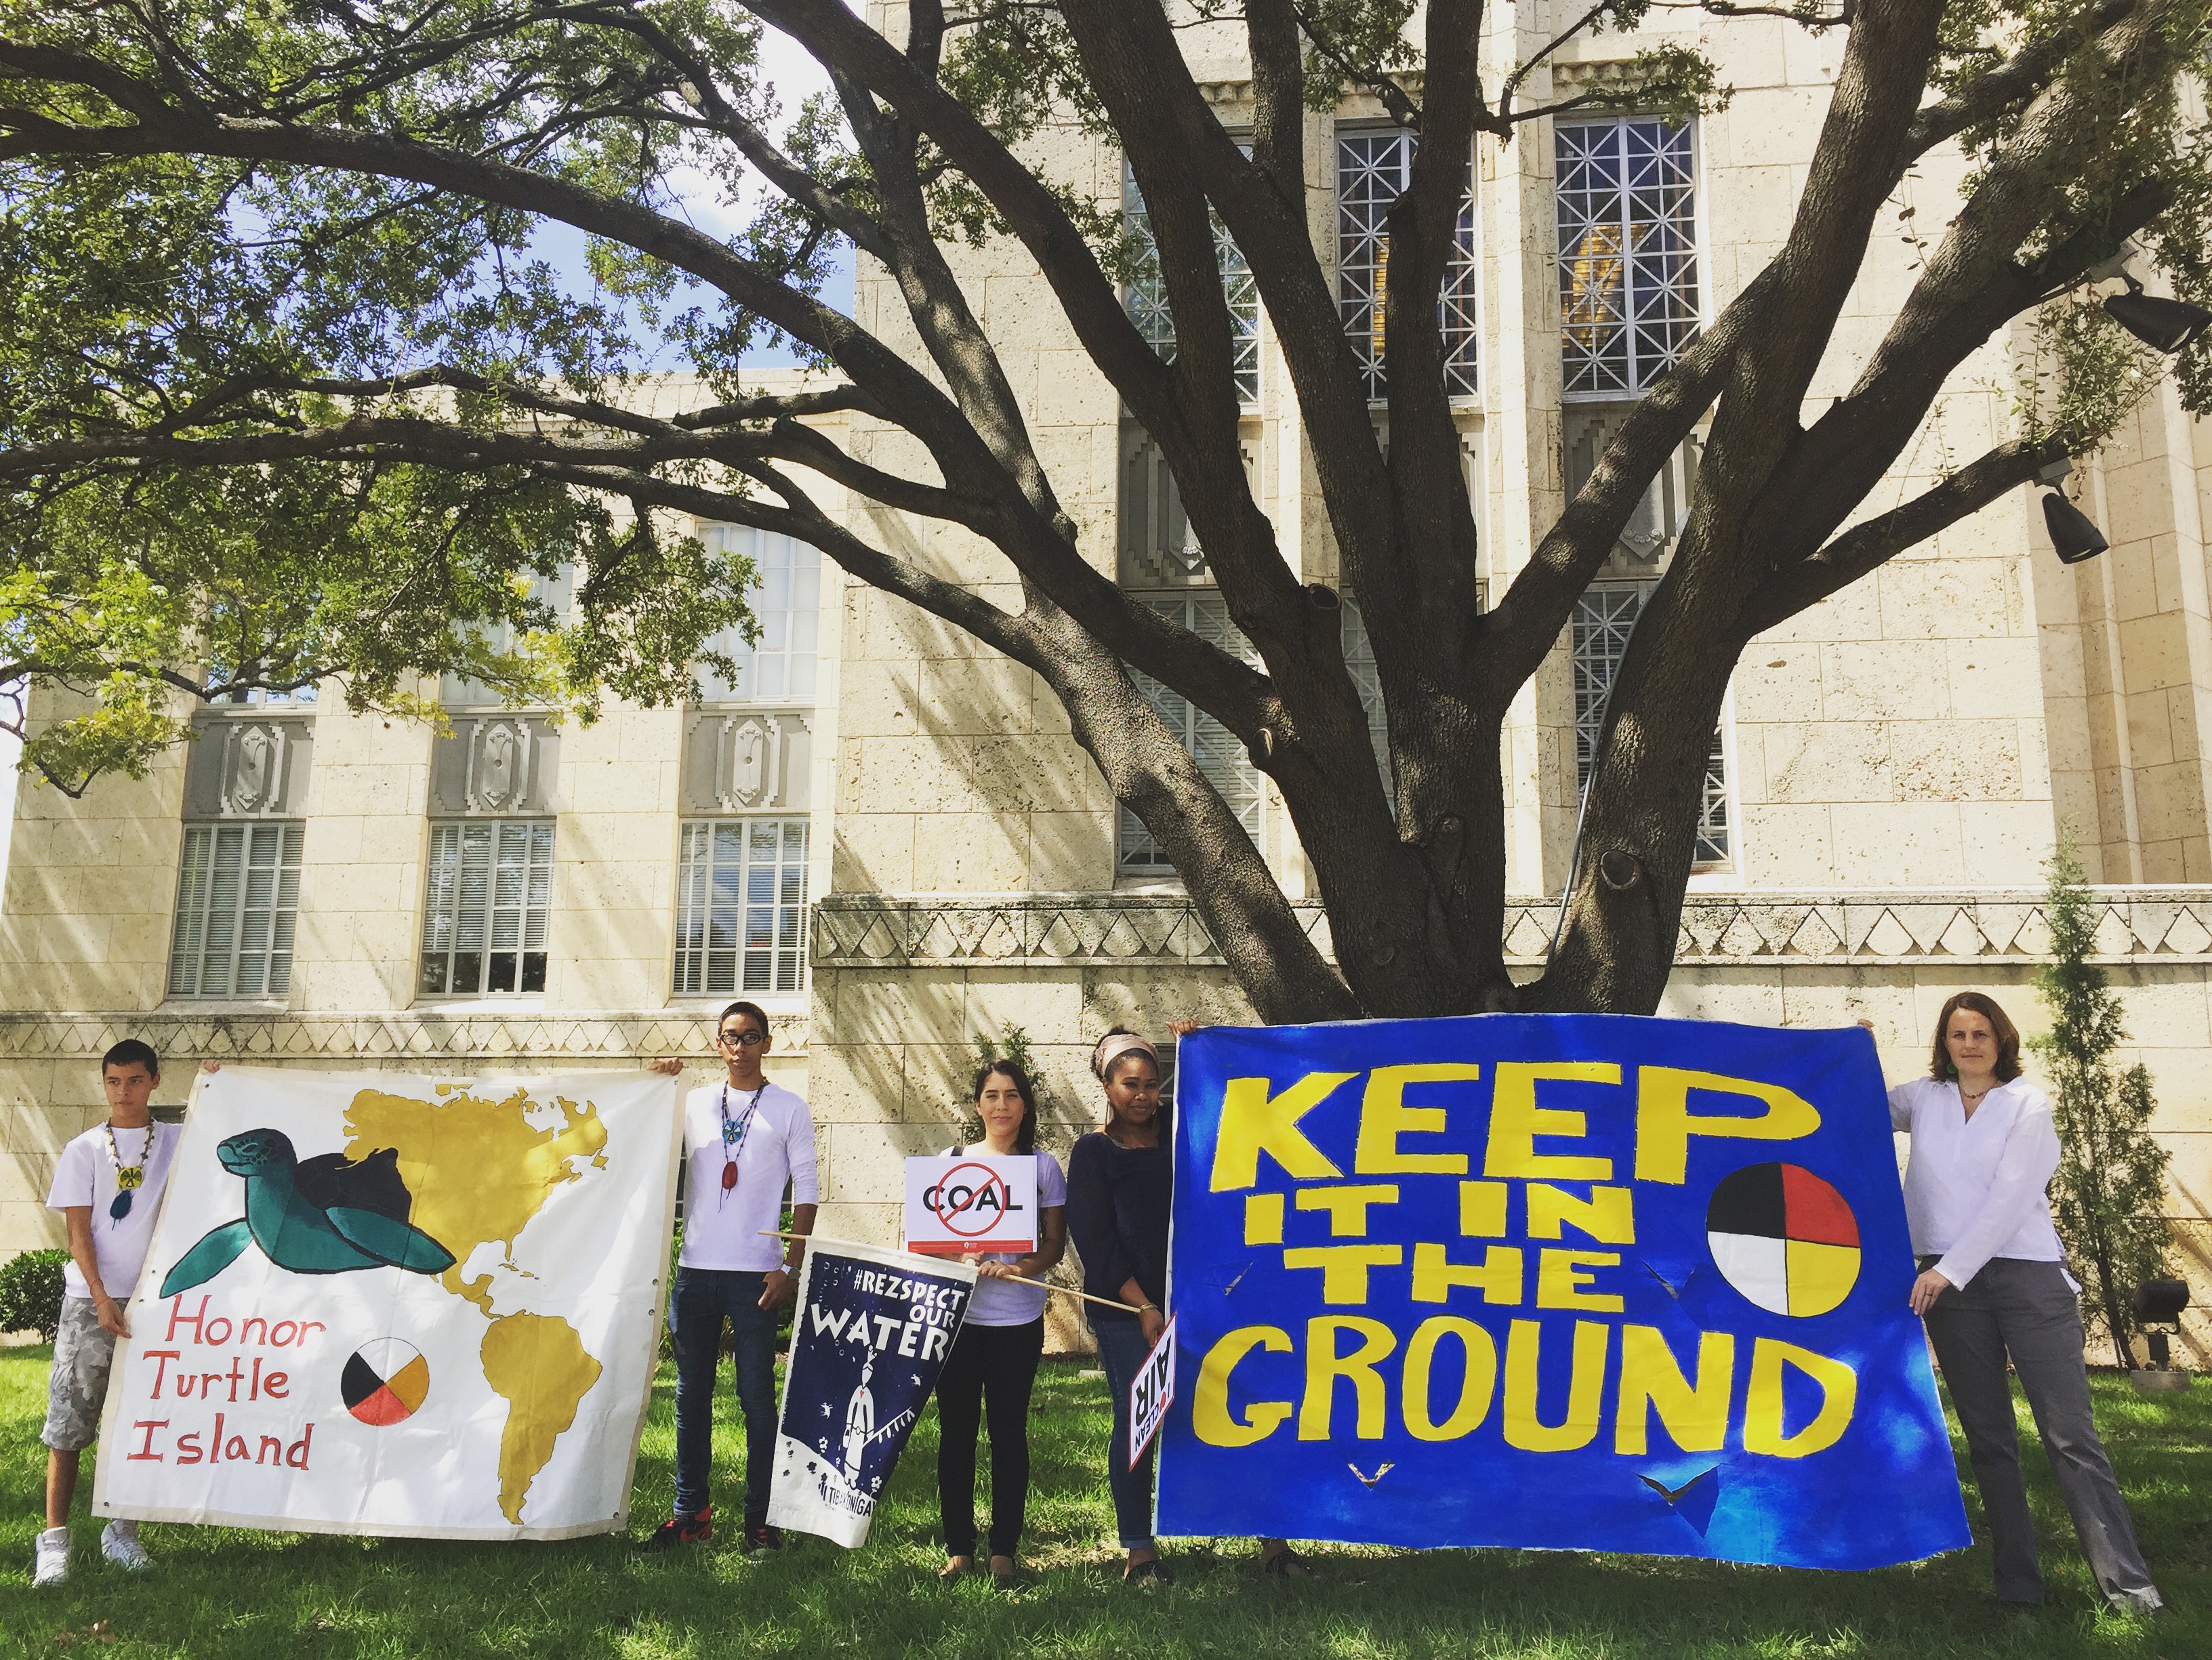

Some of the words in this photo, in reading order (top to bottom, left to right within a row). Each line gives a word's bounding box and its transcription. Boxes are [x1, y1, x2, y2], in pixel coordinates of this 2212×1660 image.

[1210, 1061, 1822, 1192] KEEP
[923, 1185, 1023, 1211] COAL
[1244, 1184, 1399, 1246] IT
[1458, 1180, 1635, 1244] IN
[853, 1268, 965, 1310] #REZSPECT
[1283, 1242, 1624, 1312] THE
[165, 1293, 326, 1347] Honor
[811, 1303, 949, 1363] WATER
[909, 1304, 956, 1329] OUR
[143, 1350, 289, 1402] Turtle
[1135, 1333, 1172, 1427] AIR
[1193, 1314, 1858, 1459] GROUND
[127, 1413, 314, 1470] Island
[1135, 1402, 1160, 1452] CLEAN
